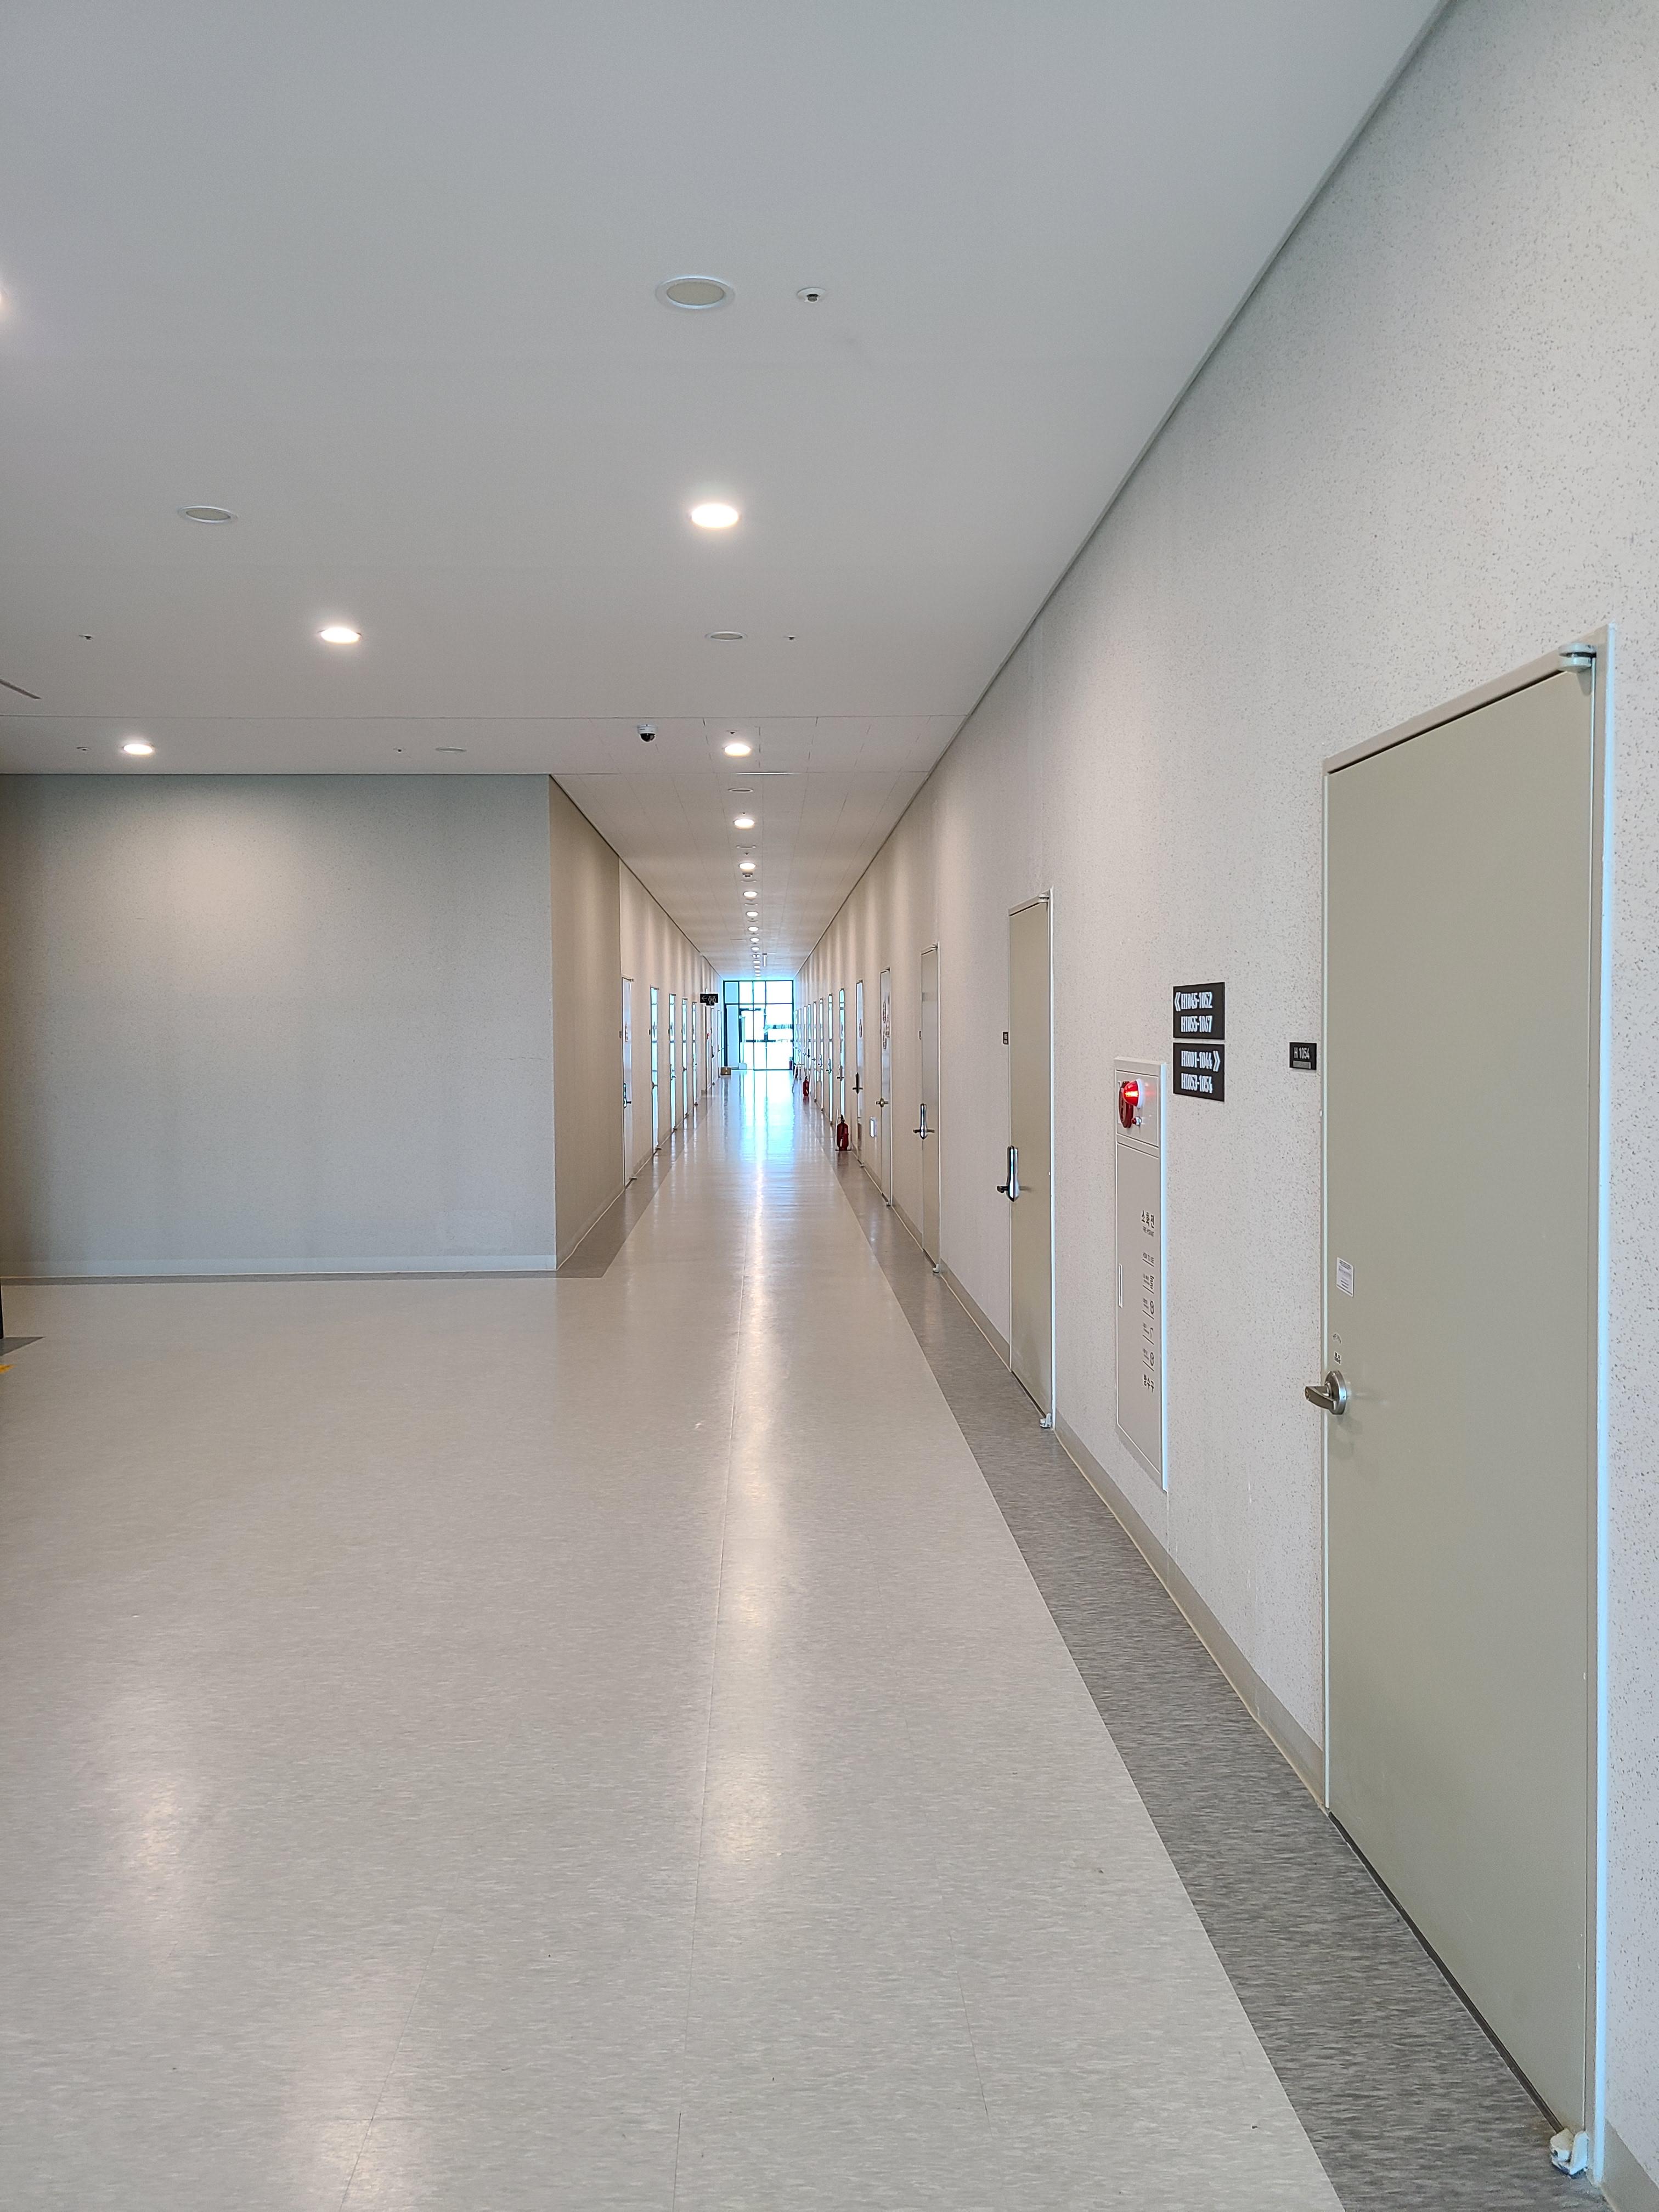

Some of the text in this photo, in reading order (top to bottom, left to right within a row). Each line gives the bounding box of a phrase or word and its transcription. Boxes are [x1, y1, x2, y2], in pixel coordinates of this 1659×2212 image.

[1181, 991, 1212, 1010] H1045-1052
[1181, 1050, 1212, 1070] H1001-1044
[1294, 1047, 1310, 1060] H 1054
[1181, 1073, 1212, 1094] H1053-1054
